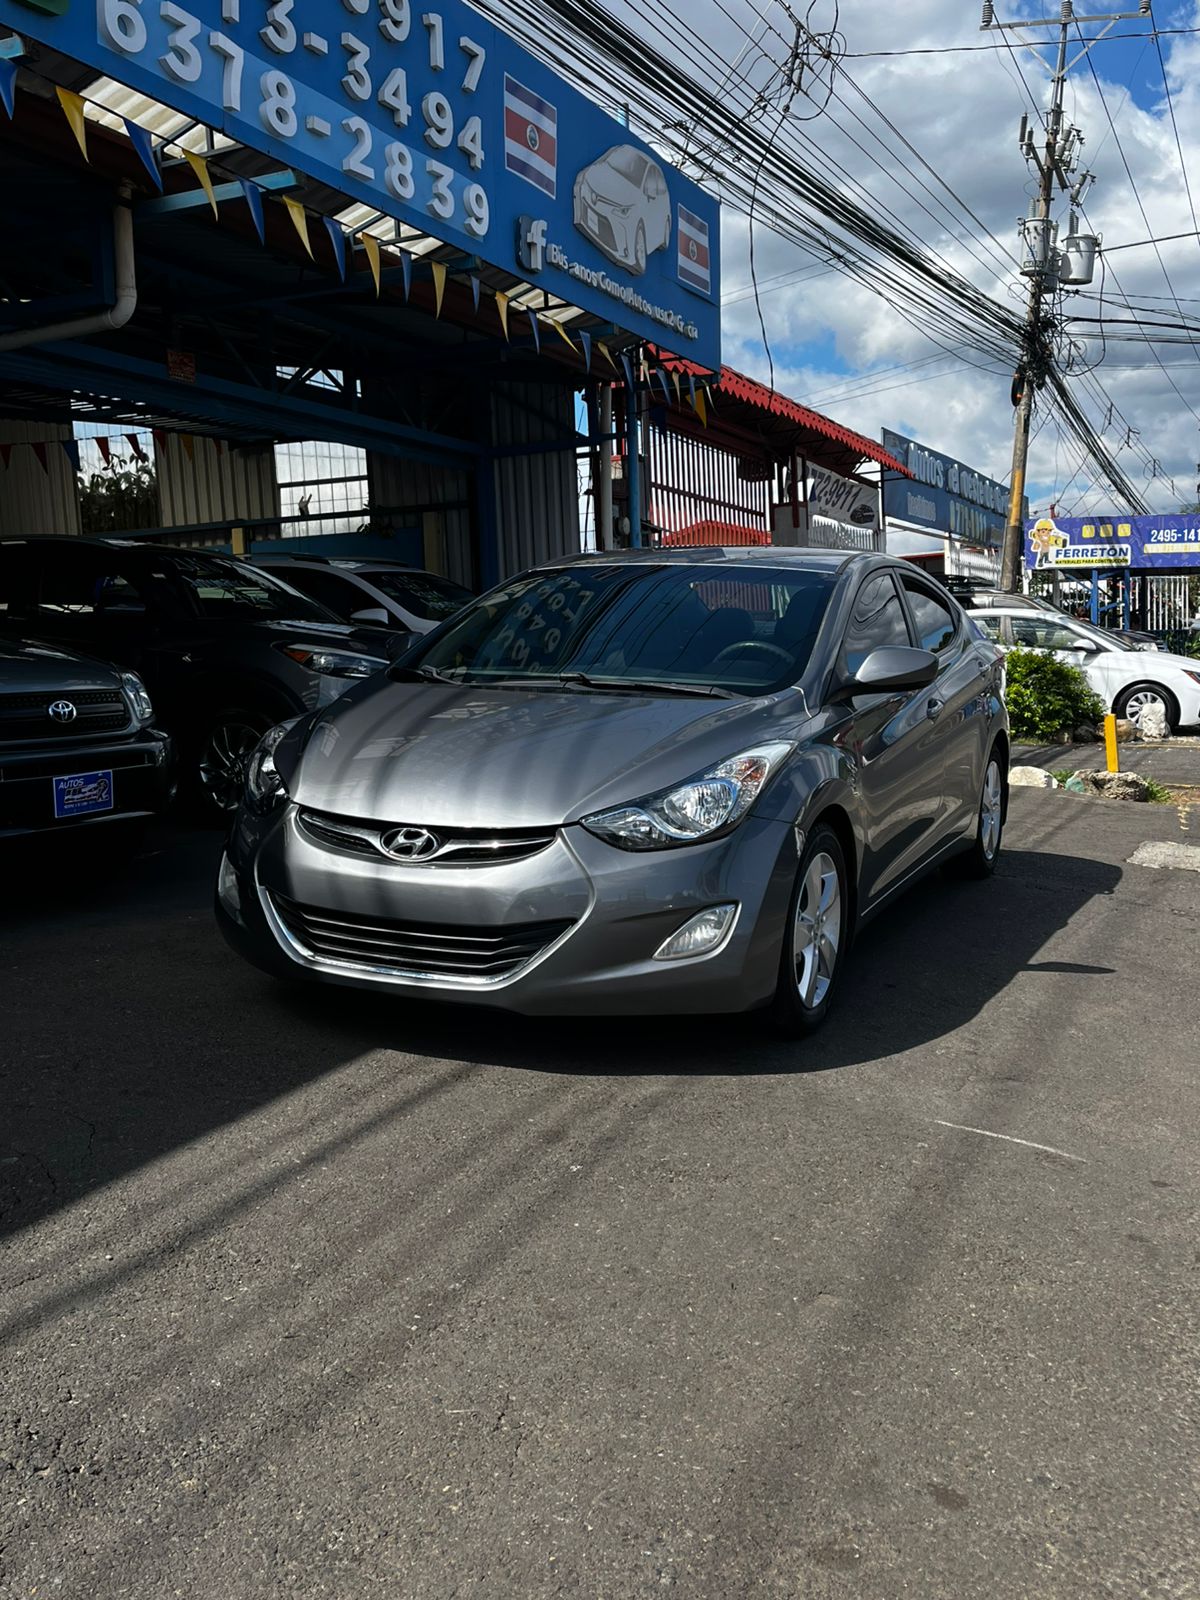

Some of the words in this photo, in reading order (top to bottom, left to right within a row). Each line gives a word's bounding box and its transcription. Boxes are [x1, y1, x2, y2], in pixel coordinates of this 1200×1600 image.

[222, 0, 487, 169] 3-3494
[342, 0, 485, 92] 917
[97, 0, 489, 236] 6378-2839
[58, 778, 84, 790] AUTOS
